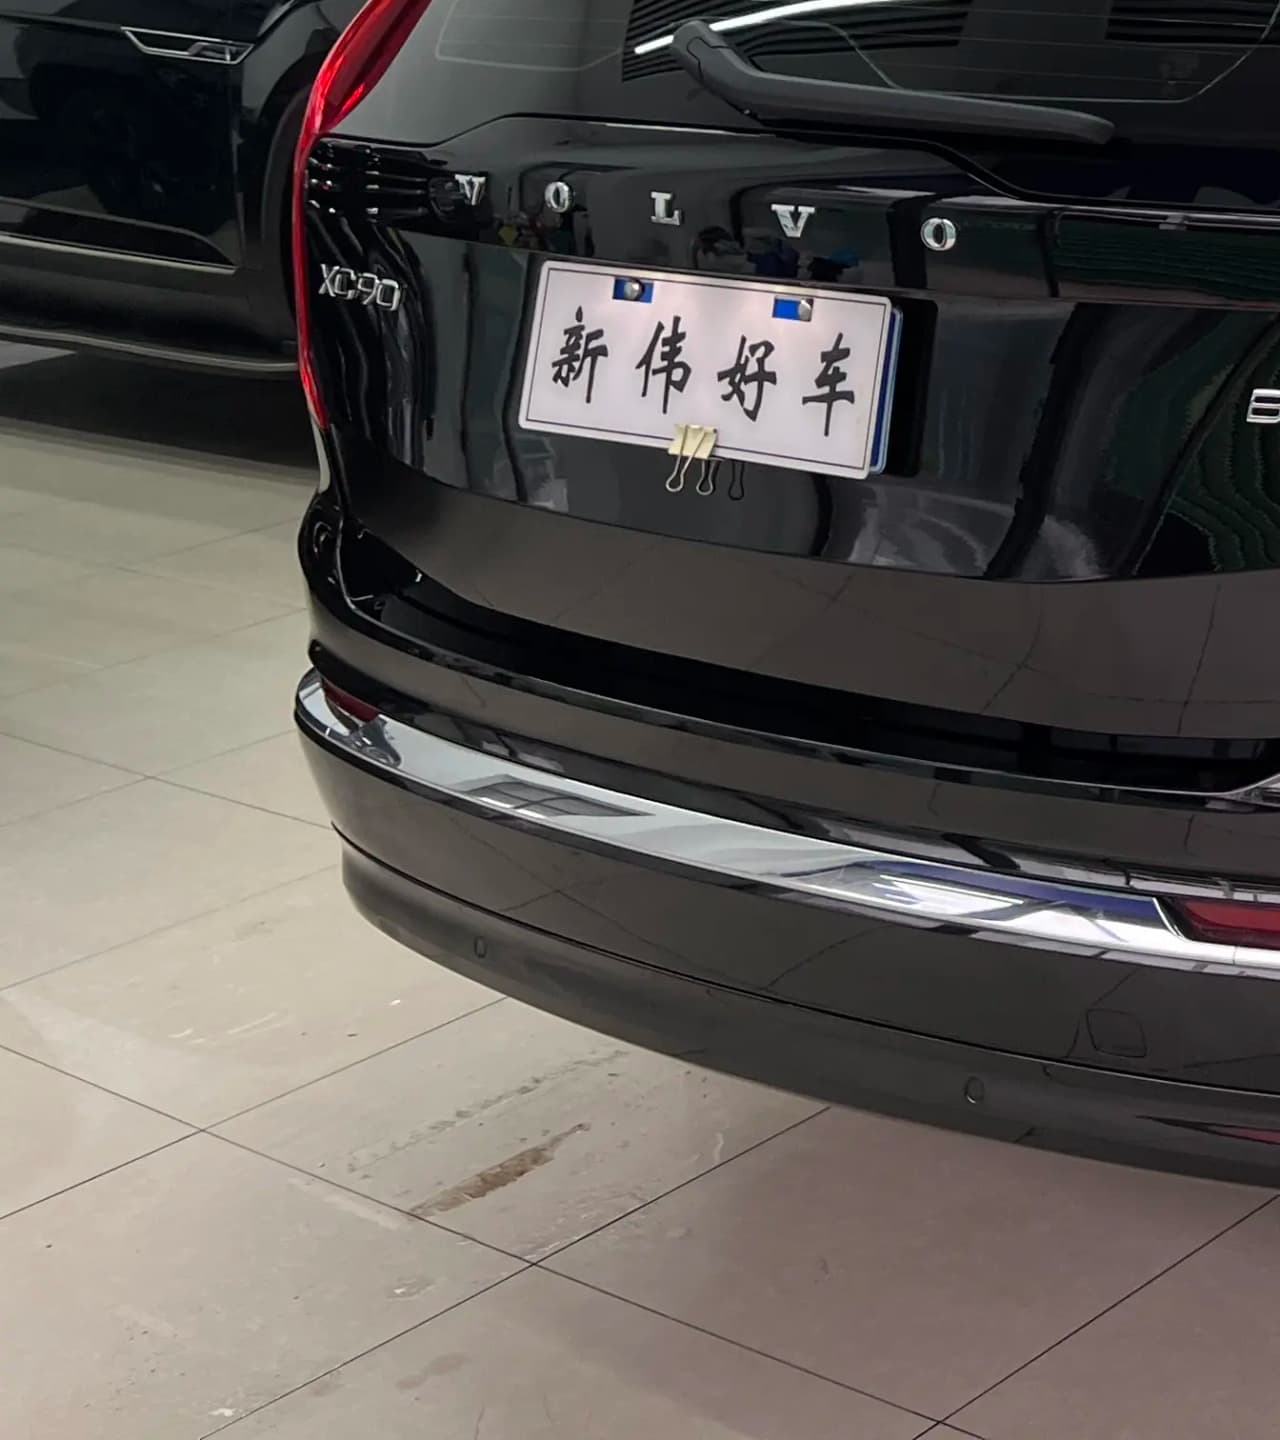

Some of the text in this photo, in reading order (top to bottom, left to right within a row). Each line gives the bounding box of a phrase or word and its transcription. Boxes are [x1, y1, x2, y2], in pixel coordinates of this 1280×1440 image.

[455, 172, 958, 252] VOLVO
[318, 263, 401, 311] XC90
[549, 305, 856, 437] 新伟好车
